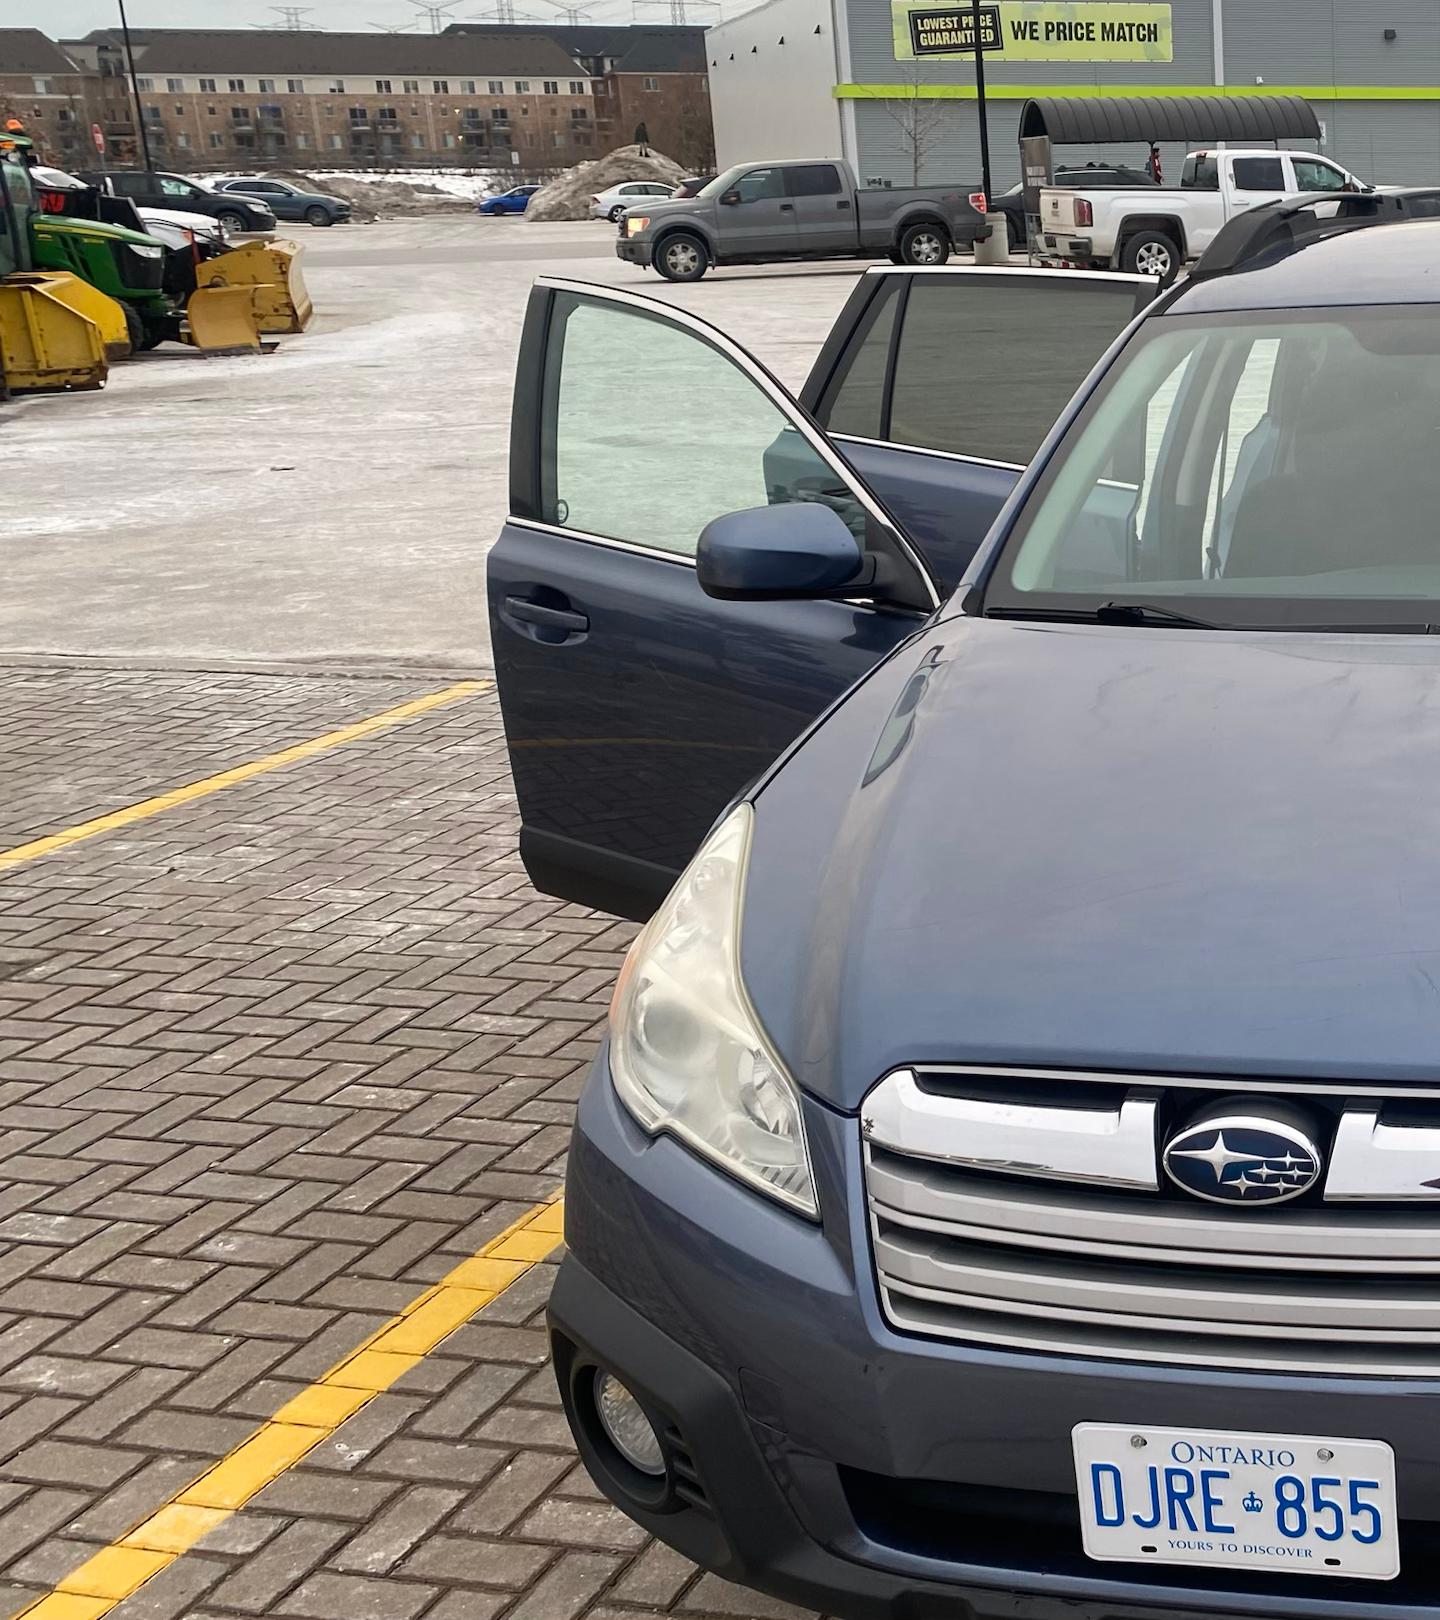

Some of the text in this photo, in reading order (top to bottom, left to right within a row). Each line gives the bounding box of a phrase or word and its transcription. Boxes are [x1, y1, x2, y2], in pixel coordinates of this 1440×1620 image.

[917, 14, 993, 31] LOWEST PRCE
[1010, 20, 1158, 42] WE PRICE MATCH
[1171, 1441, 1295, 1469] ONTARIO
[1090, 1463, 1382, 1544] DJRE 855
[1167, 1539, 1313, 1558] YOURS TO DISCOVER
